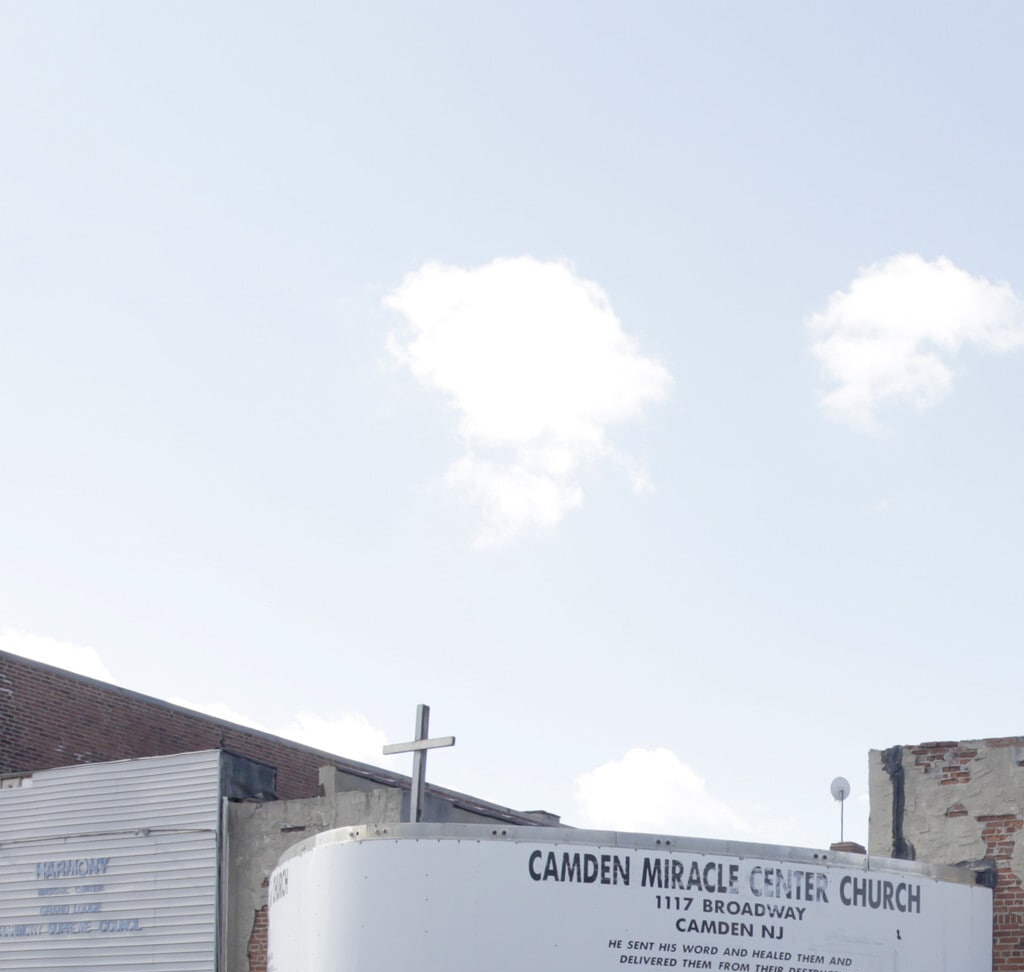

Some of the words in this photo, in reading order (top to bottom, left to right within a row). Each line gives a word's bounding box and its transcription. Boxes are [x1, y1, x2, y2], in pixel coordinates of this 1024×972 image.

[35, 857, 110, 880] HARMONY
[529, 850, 630, 886] CAMDEN
[641, 857, 739, 894] MIRACLE
[750, 865, 829, 903] CENTER
[839, 875, 921, 914] CHURCH
[655, 895, 693, 911] 1117
[703, 899, 806, 921] BROADWAY
[99, 918, 143, 933] COUNCIL
[675, 918, 754, 937] CAMDEN
[761, 924, 784, 940] NJ
[608, 939, 623, 949] HE
[627, 940, 655, 951] SENT
[658, 943, 677, 953] HIS
[682, 944, 719, 956] WORD
[722, 947, 748, 958] AND
[752, 949, 792, 961] HEALED
[797, 953, 825, 964] THEM
[829, 956, 853, 967] AND
[619, 954, 678, 967] DELIVERED
[682, 959, 712, 969] THEM
[718, 961, 750, 972] FROM
